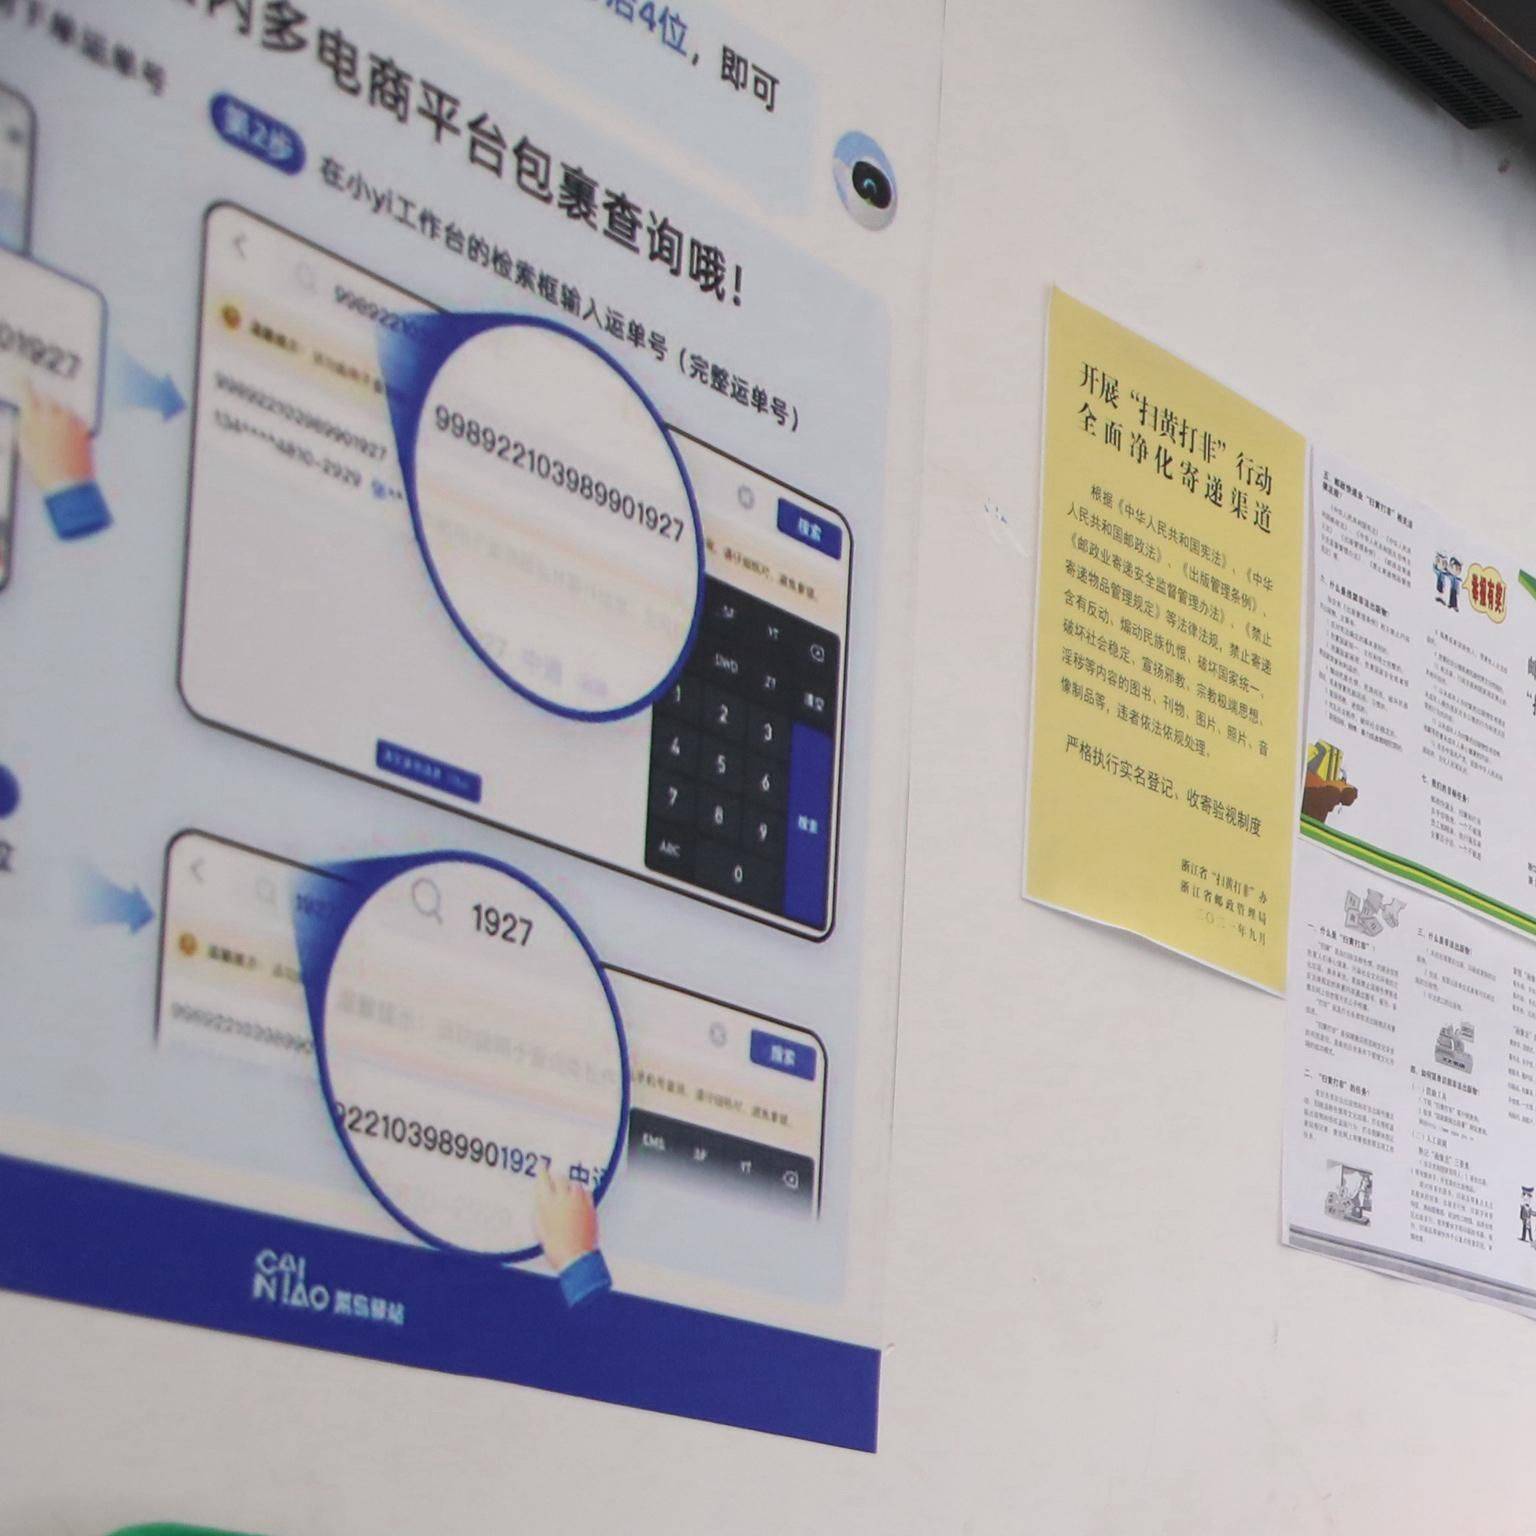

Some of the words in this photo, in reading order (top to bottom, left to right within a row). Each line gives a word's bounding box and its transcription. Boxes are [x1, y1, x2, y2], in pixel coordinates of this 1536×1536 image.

[434, 404, 686, 545] 998922103989901927
[1078, 402, 1272, 534] 全面净化寄递渠道
[1080, 361, 1273, 496] 开展“扫黄打非”行动
[1065, 734, 1262, 838] 严格执行实名登记、收寄验视制度
[471, 902, 534, 948] 1927
[254, 1248, 306, 1281] CAI
